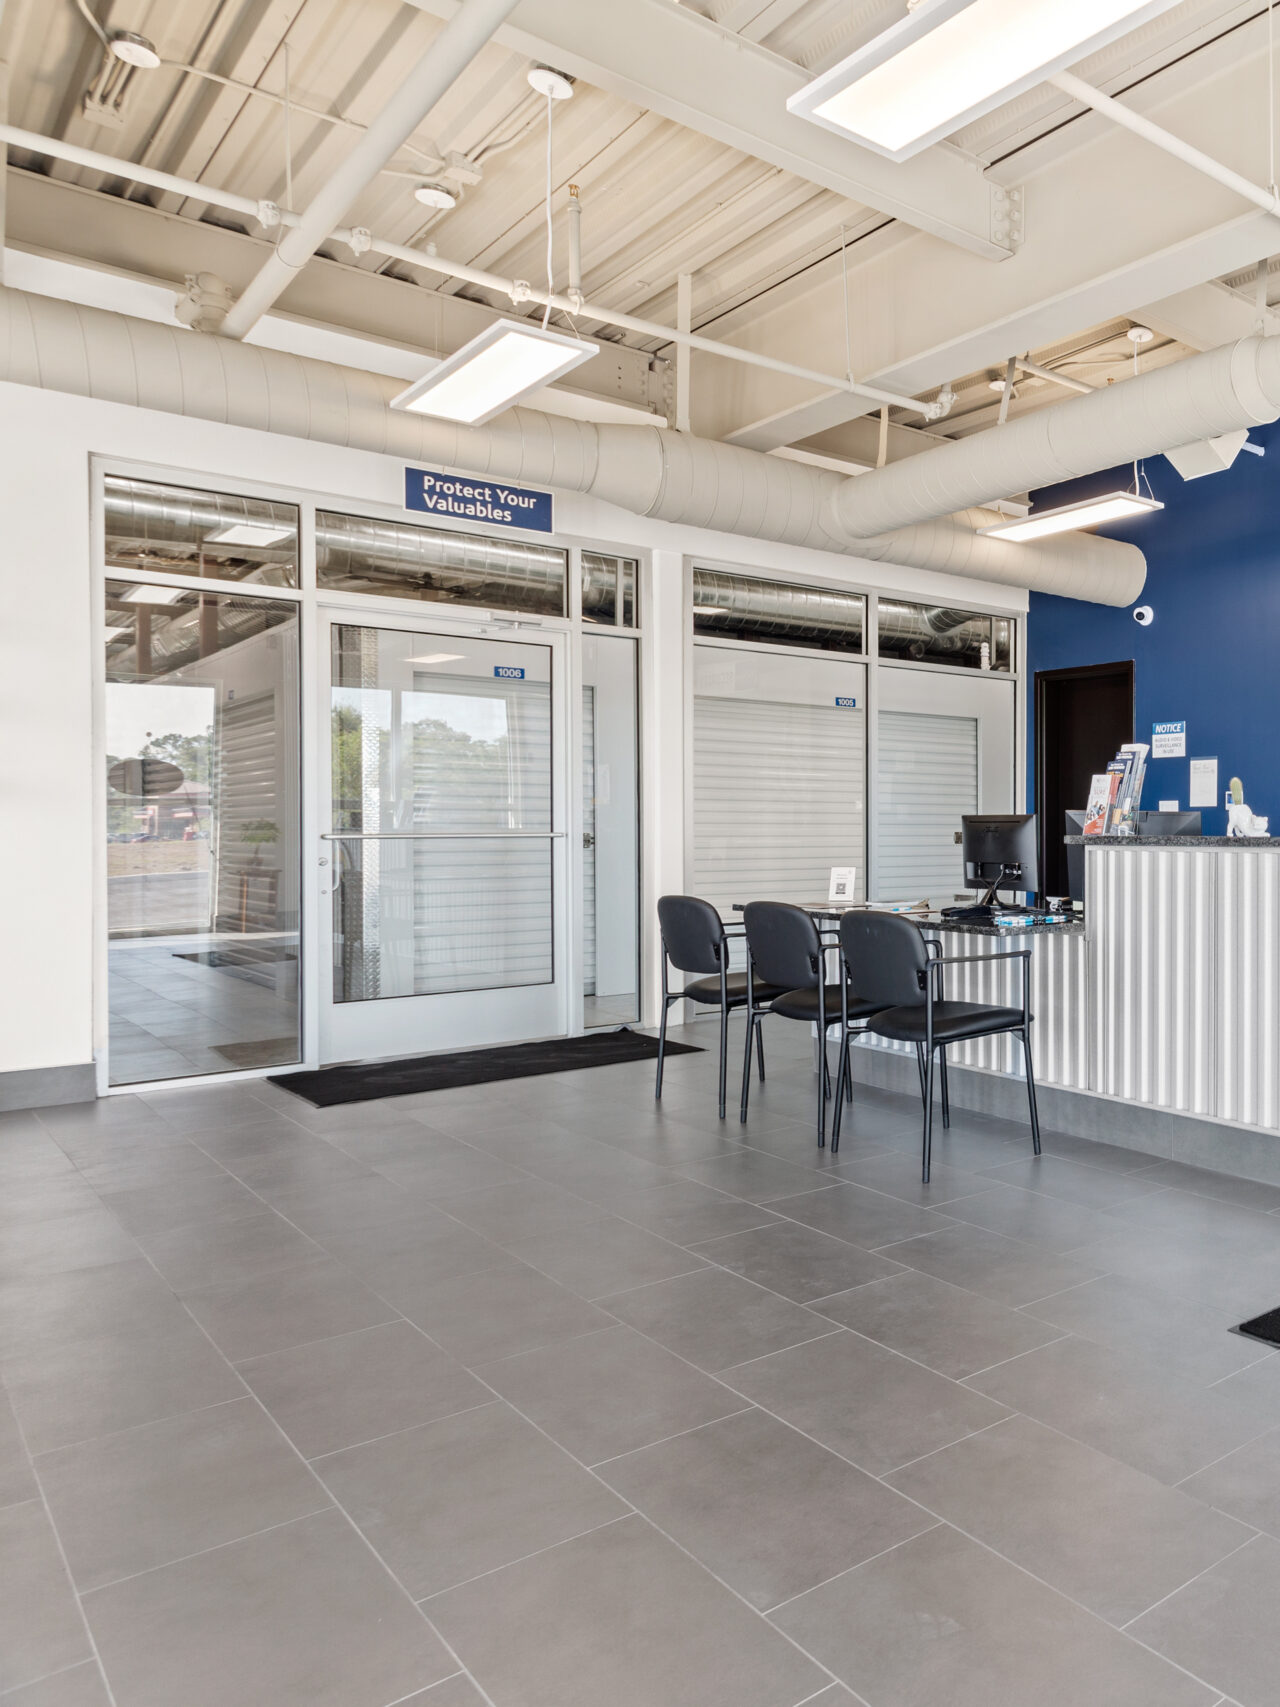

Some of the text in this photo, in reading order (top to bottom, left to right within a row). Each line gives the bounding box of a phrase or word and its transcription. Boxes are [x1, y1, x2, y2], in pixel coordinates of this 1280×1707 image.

[423, 475, 536, 509] Protect Your
[423, 493, 512, 522] Valuables
[498, 668, 522, 678] 1006
[1155, 723, 1182, 733] NOTICE
